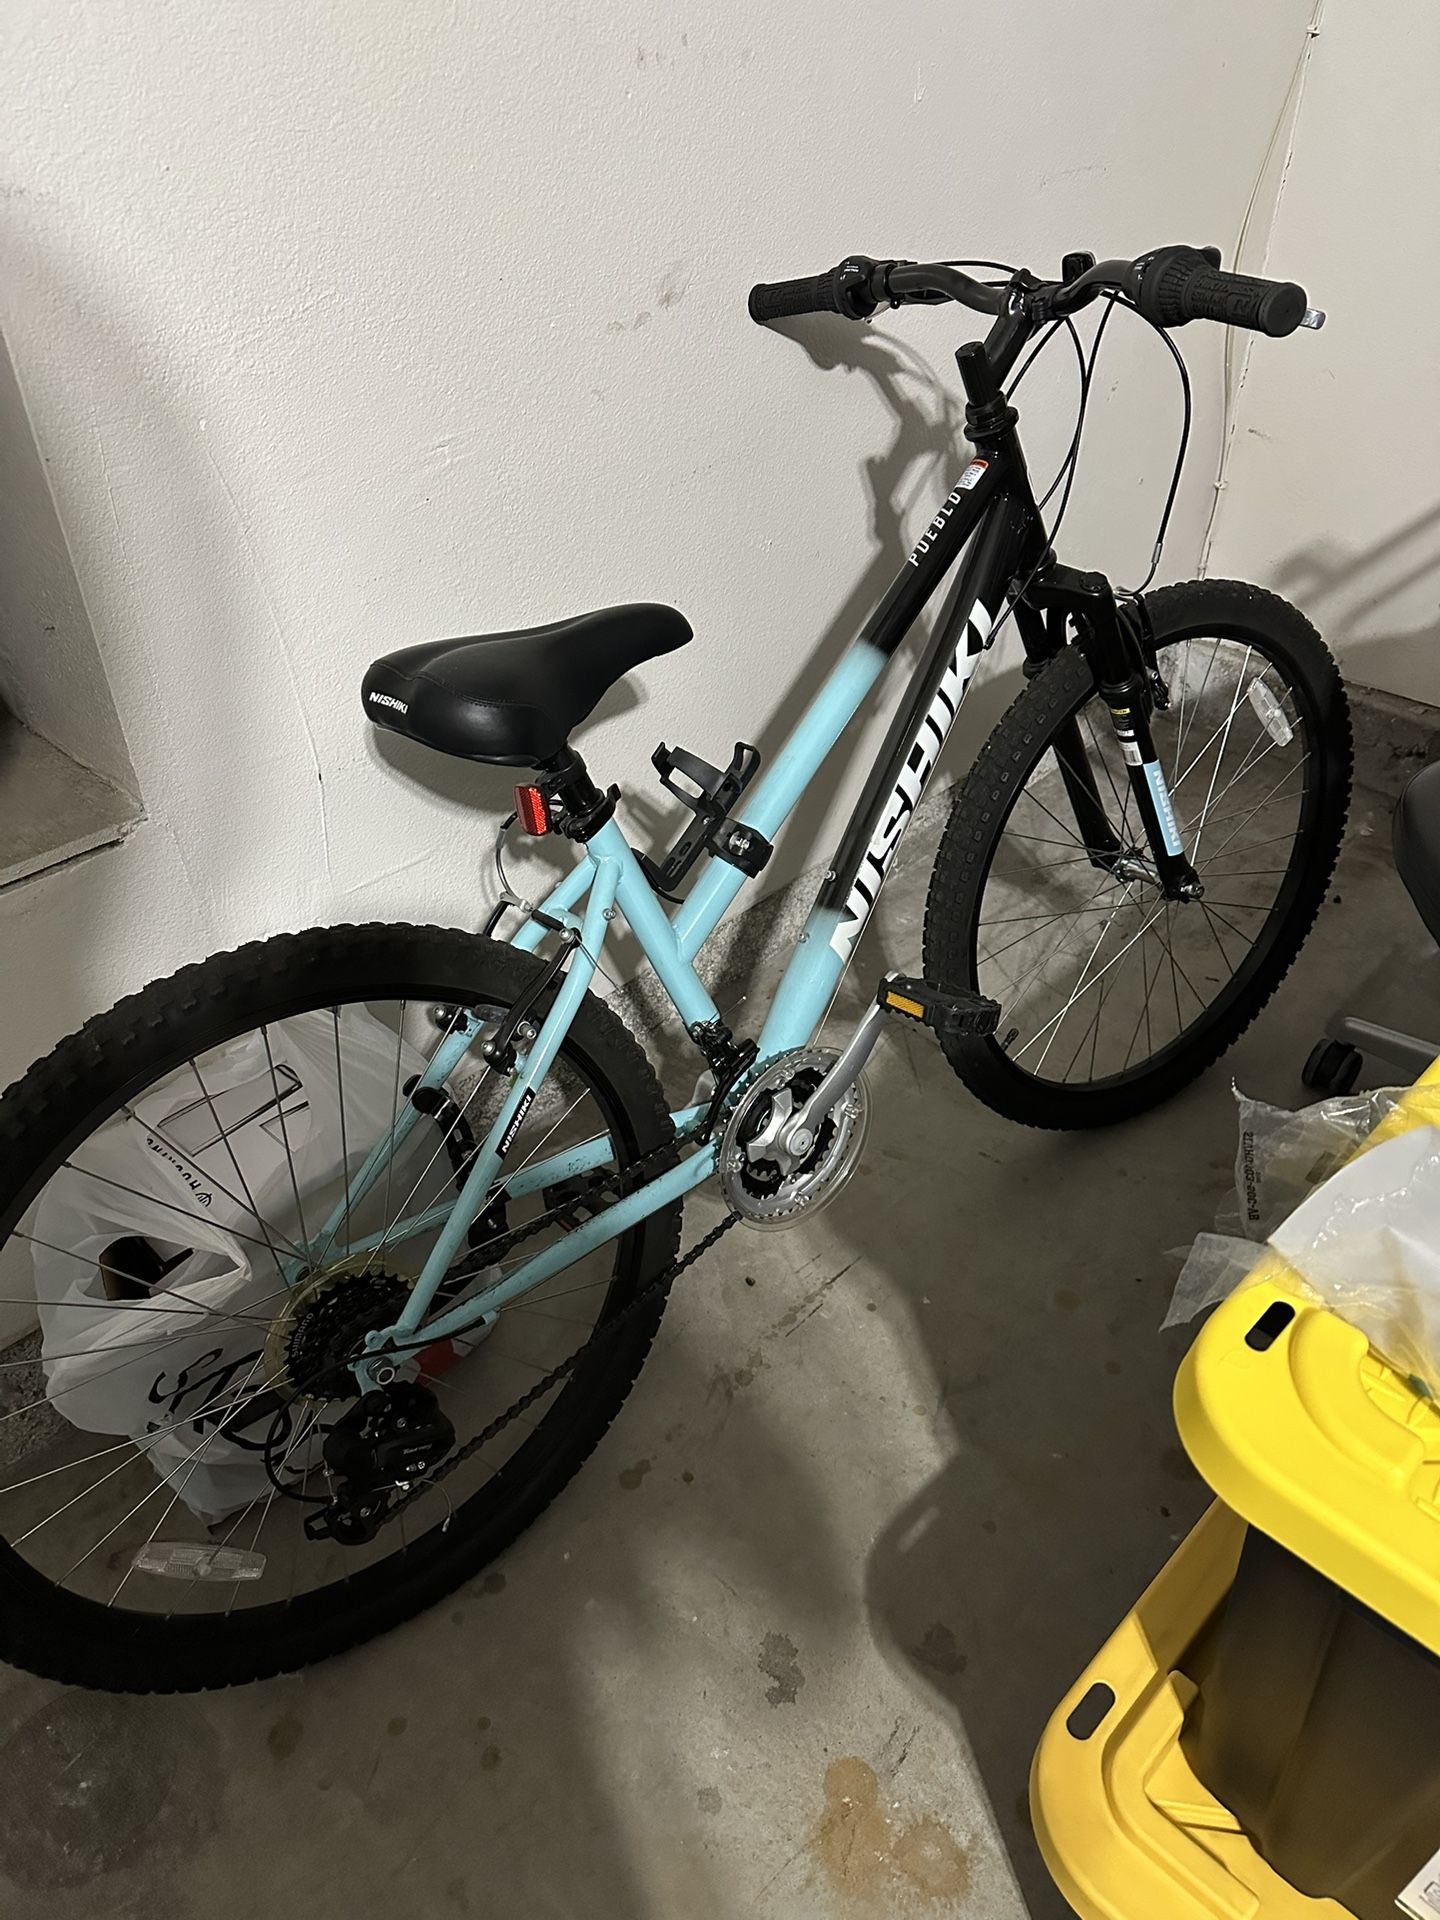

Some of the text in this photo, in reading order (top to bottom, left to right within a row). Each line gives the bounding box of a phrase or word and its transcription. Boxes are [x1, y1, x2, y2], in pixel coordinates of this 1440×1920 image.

[909, 492, 961, 567] PUEBLO
[369, 691, 408, 714] NISHIKI
[829, 598, 995, 965] NISHIKI
[1153, 770, 1180, 847] NISHIKI
[502, 1095, 531, 1153] NISHIKI
